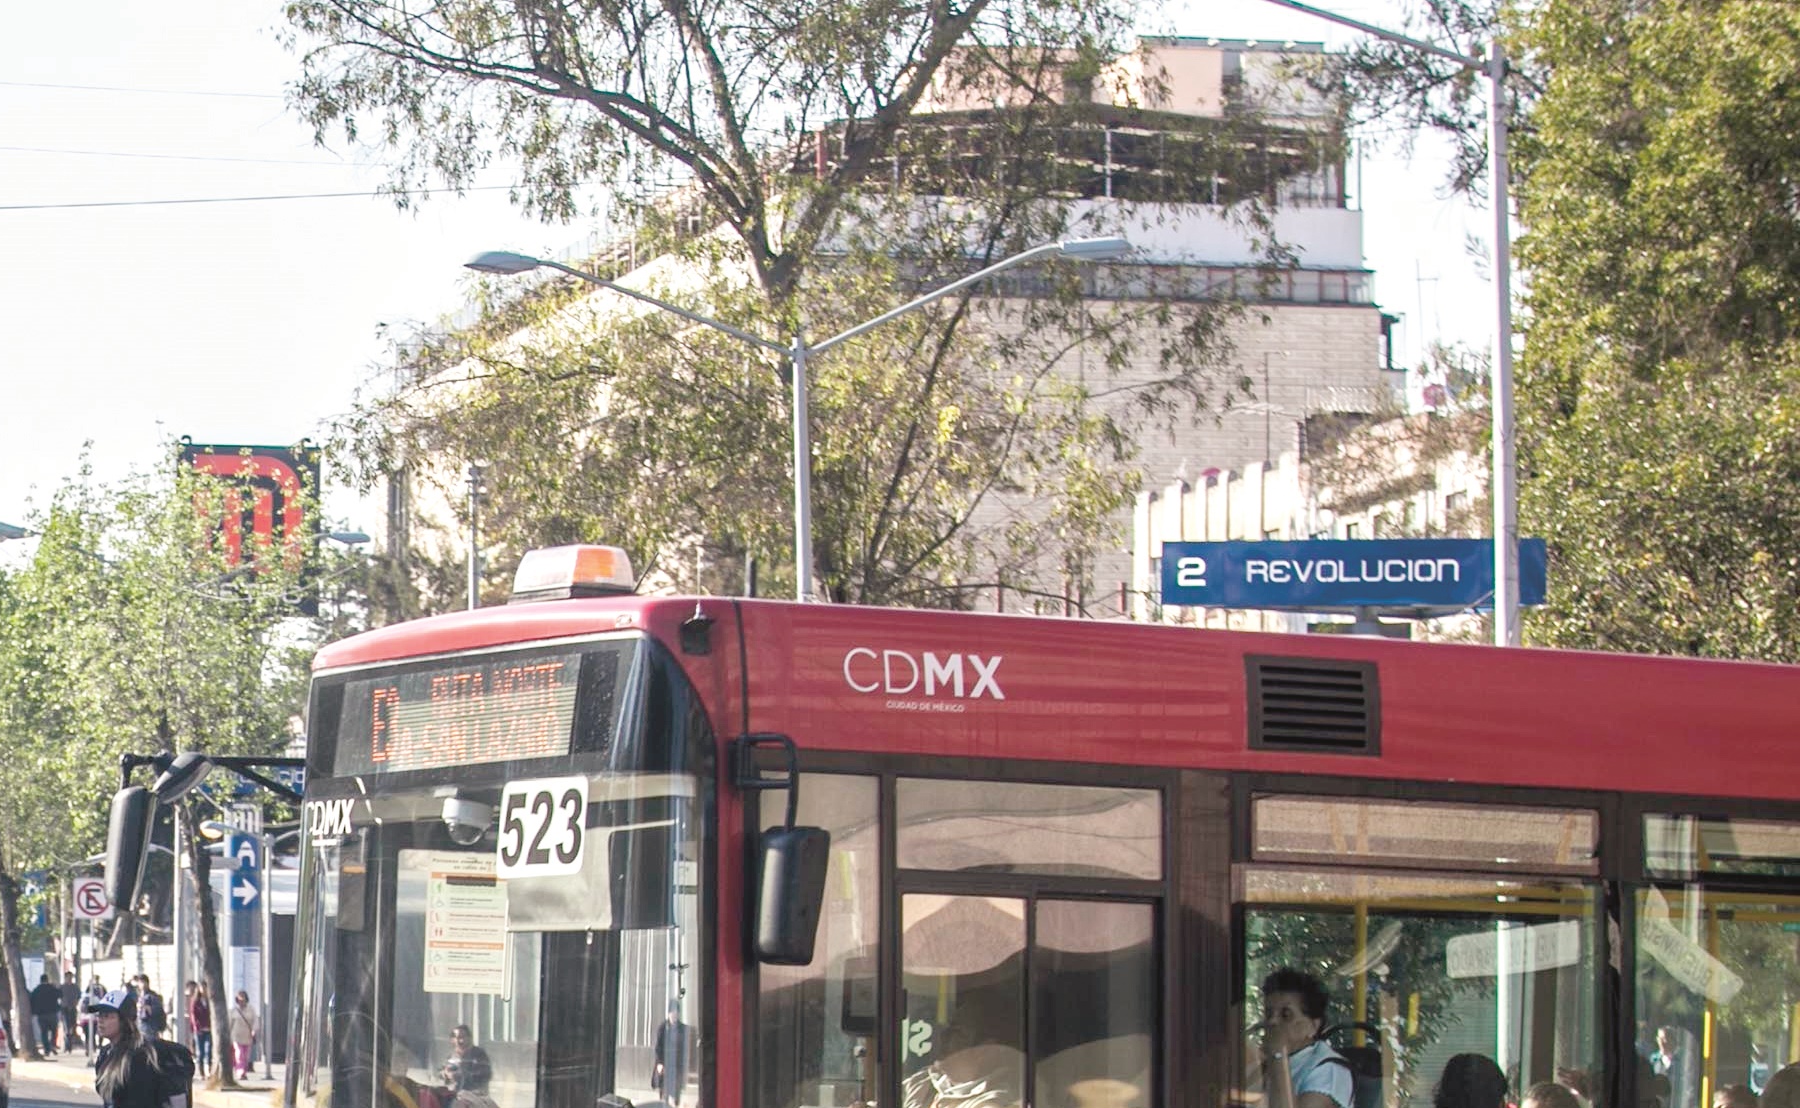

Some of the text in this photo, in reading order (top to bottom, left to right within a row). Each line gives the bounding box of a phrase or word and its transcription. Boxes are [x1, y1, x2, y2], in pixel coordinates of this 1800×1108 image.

[1177, 557, 1460, 587] 2 REVOLUCION
[843, 647, 1006, 700] CDMX
[886, 700, 917, 710] CIUDAD
[919, 702, 931, 711] DE
[501, 788, 583, 868] 523
